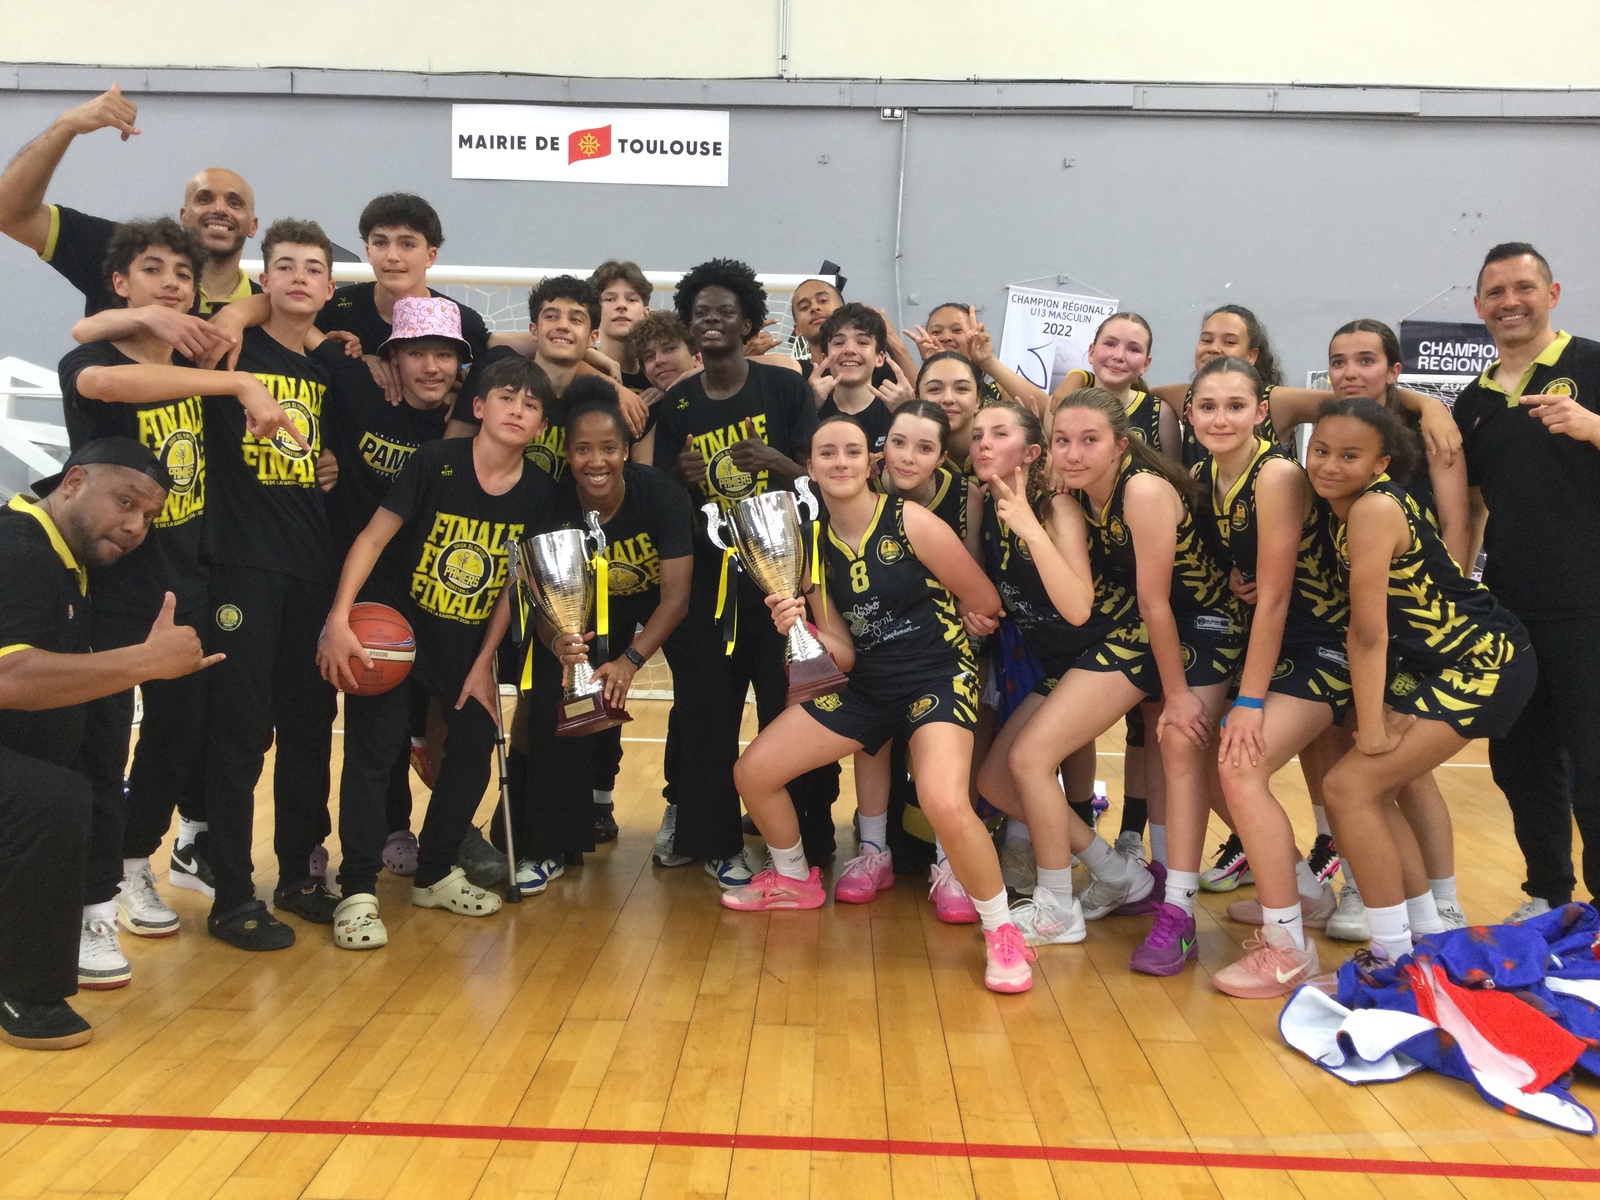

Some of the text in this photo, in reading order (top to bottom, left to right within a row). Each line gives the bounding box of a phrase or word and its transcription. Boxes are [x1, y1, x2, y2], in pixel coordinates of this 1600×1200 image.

[458, 134, 722, 156] MAIRIE DE TOULOUSE
[1011, 294, 1114, 316] CHAMPION RÉGIONAL 2
[1030, 308, 1092, 323] U13 MASCULIN
[1042, 322, 1073, 337] 2022
[1417, 356, 1492, 372] REGIONA
[719, 474, 753, 489] PAMIERS
[443, 564, 481, 588] PAMIERS
[849, 559, 870, 594] 8
